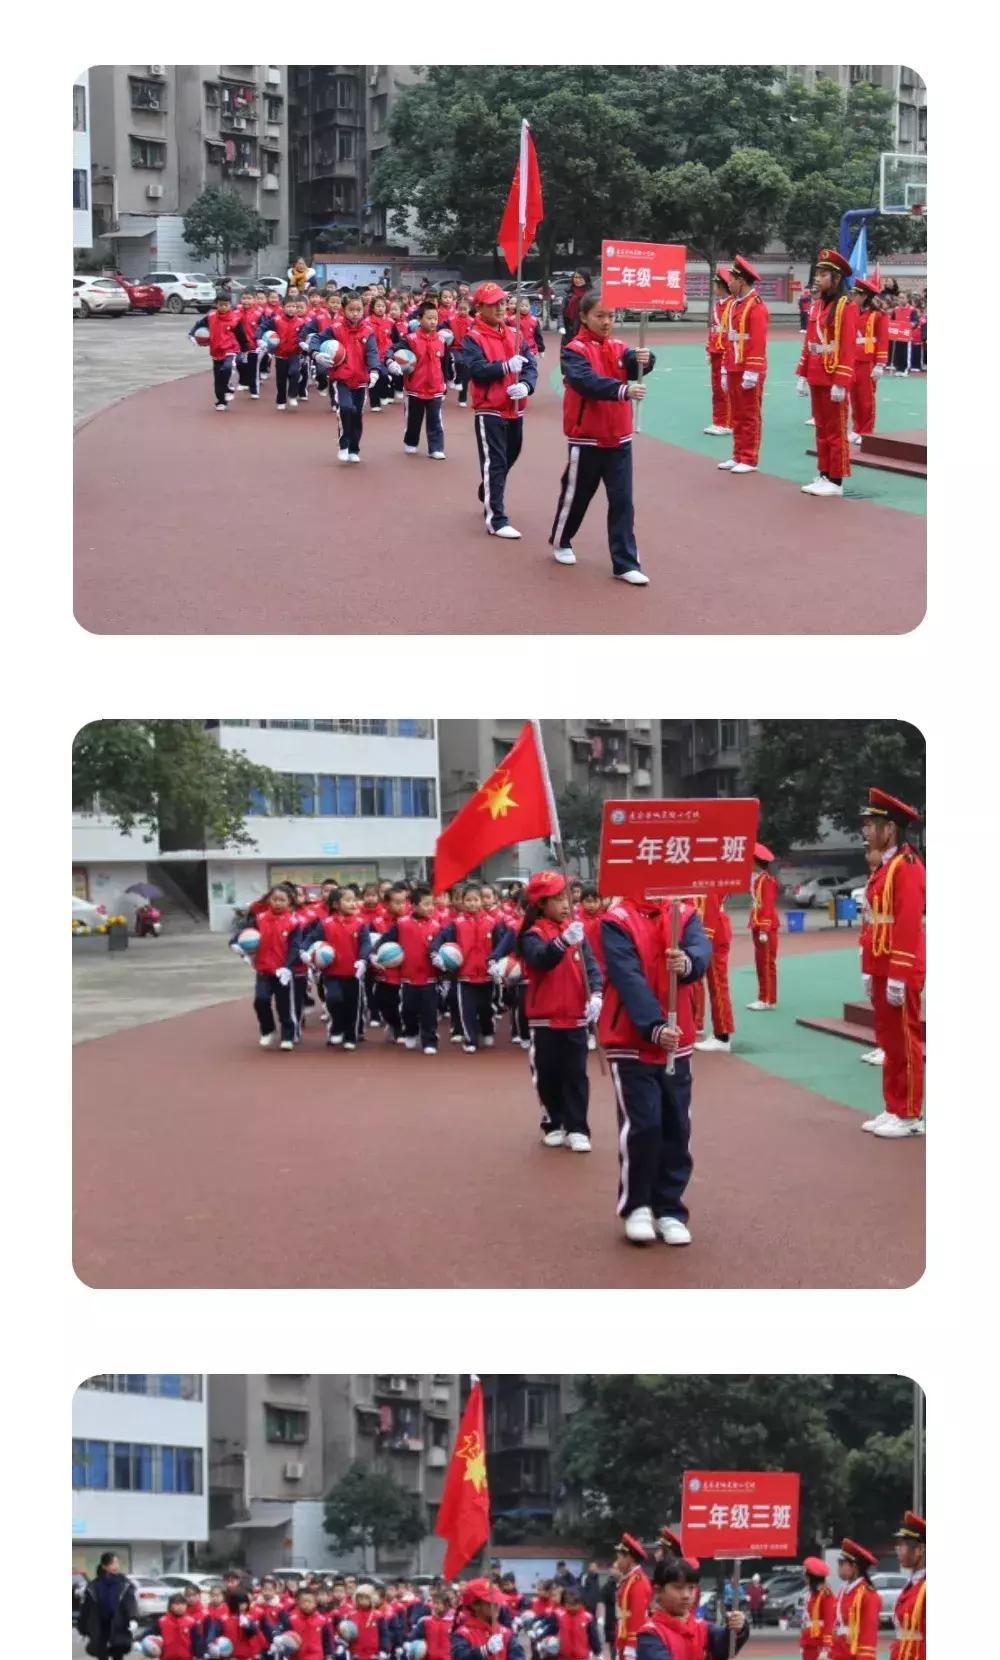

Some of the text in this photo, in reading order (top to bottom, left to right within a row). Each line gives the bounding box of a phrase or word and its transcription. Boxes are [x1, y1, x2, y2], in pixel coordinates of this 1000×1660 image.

[605, 266, 680, 288] 二年级一班
[607, 835, 747, 864] 二年级二班
[688, 1503, 791, 1529] 二年级三班
